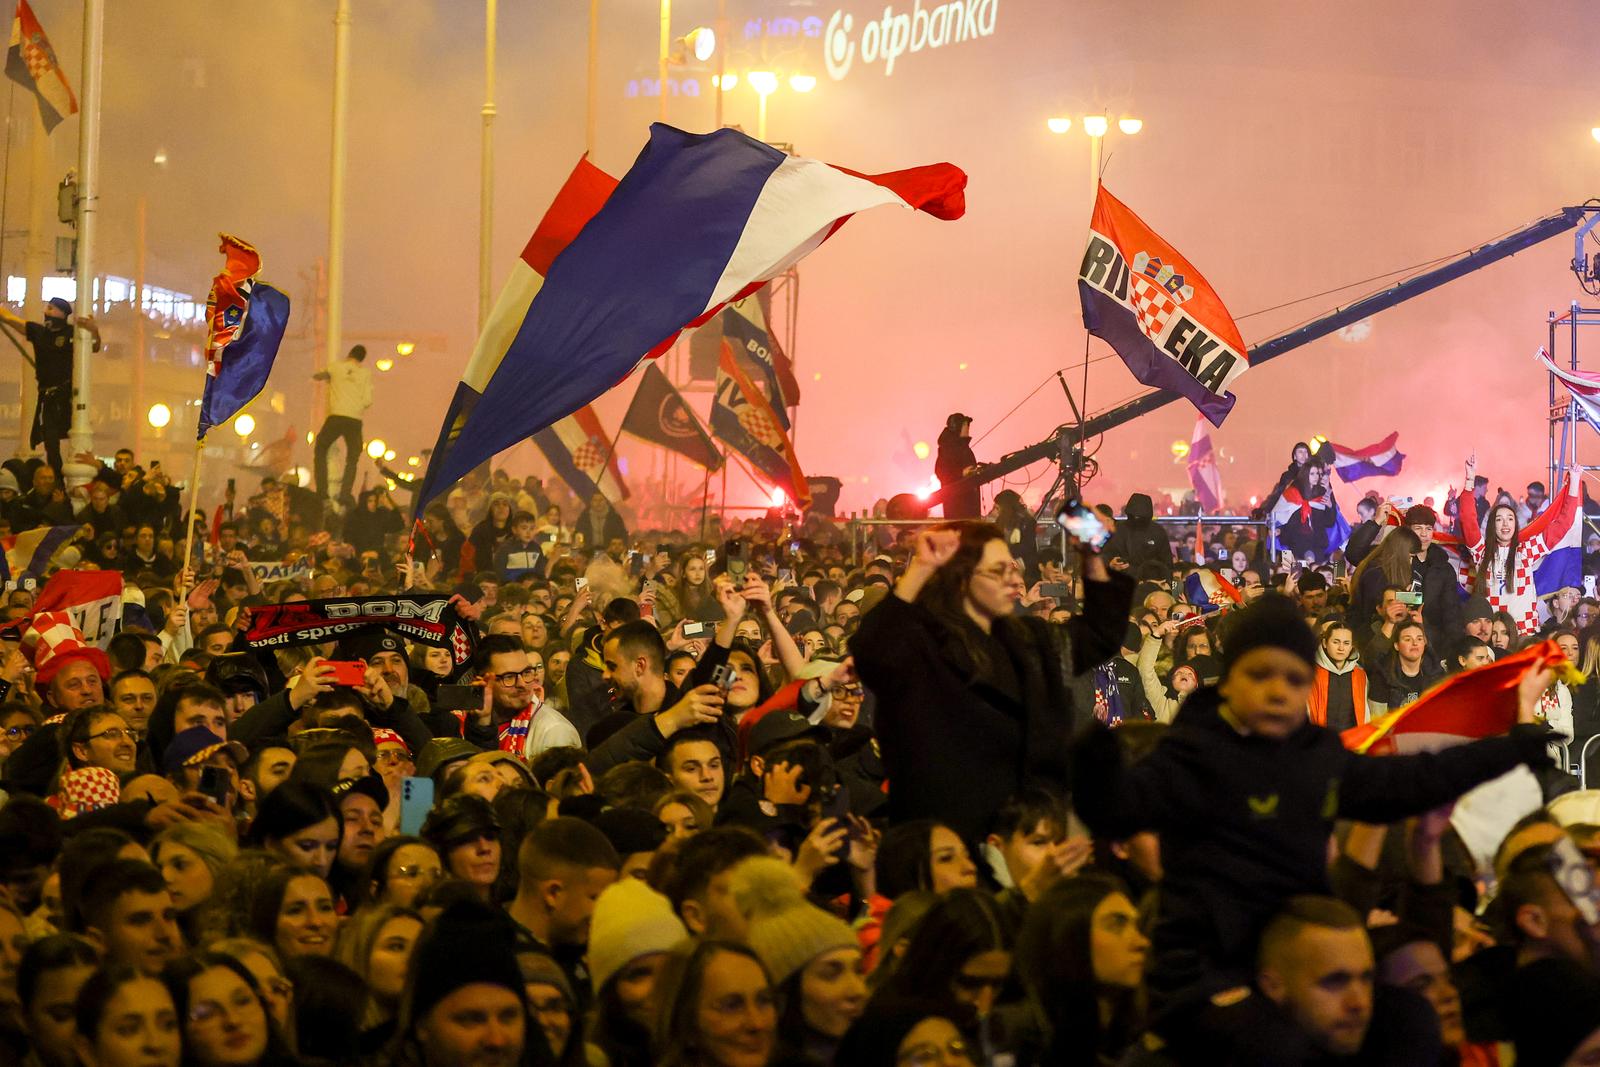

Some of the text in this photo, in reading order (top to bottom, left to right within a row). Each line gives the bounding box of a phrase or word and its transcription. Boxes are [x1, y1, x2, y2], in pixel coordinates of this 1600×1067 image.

[325, 600, 449, 624] DOM
[249, 632, 290, 648] sveti
[397, 622, 443, 642] mrijeti
